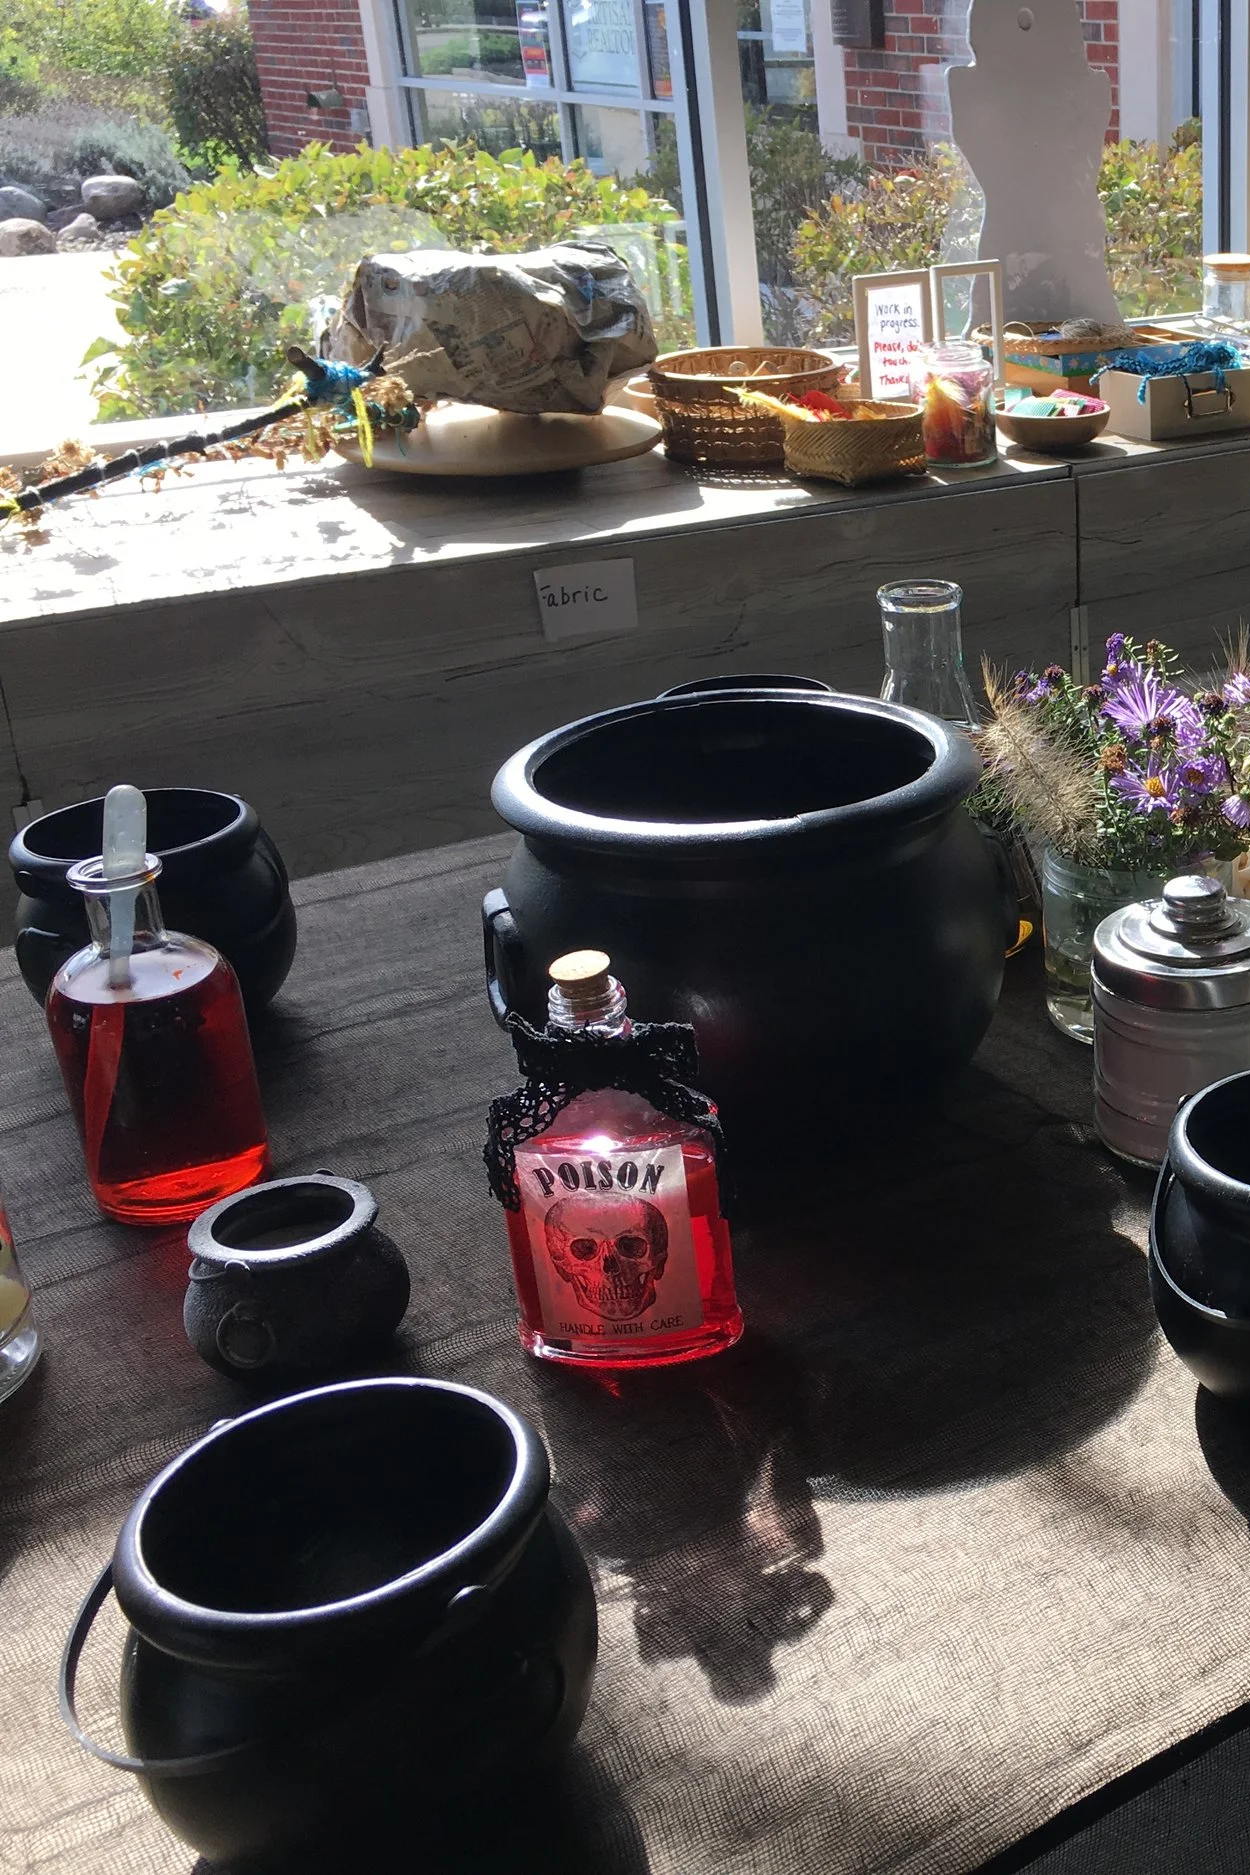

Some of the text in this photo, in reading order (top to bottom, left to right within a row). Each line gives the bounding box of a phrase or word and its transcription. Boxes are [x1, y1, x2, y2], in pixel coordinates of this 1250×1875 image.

[875, 302, 912, 316] Work in
[880, 317, 920, 333] progress.
[532, 1161, 664, 1198] POISON
[560, 1315, 684, 1335] HANDLE WITH CARE
